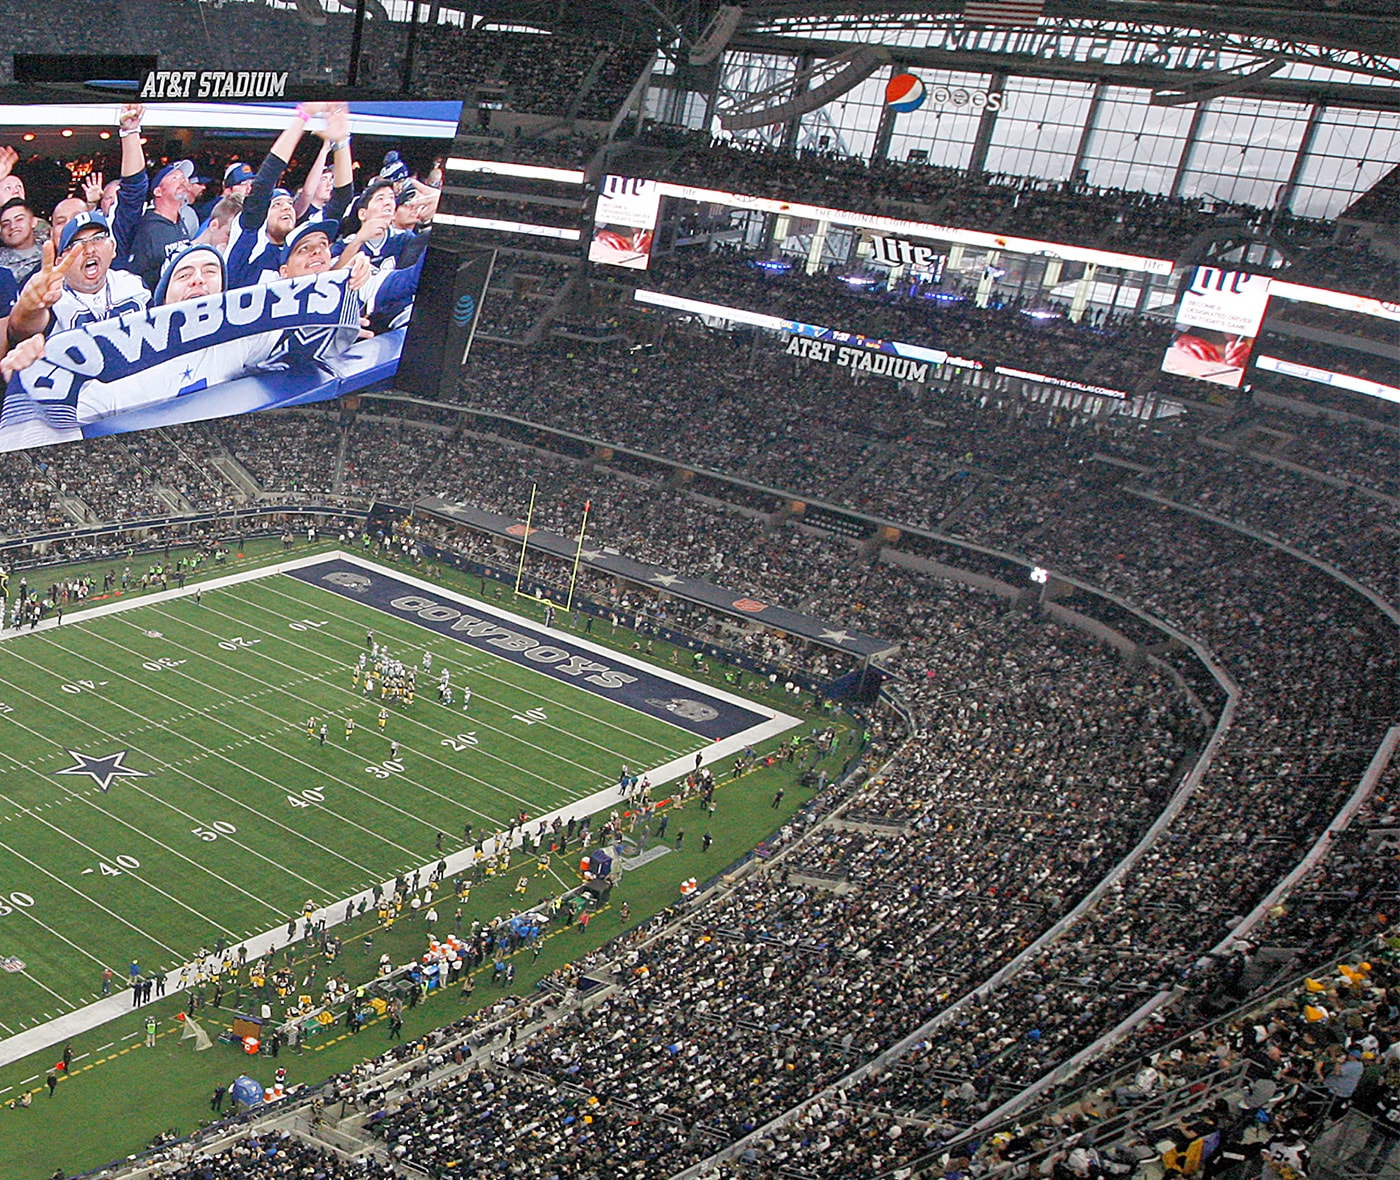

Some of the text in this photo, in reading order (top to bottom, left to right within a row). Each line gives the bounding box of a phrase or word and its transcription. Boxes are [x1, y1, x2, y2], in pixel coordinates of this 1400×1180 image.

[140, 71, 288, 98] AT&T STADIUM
[870, 235, 934, 268] Lite
[19, 272, 348, 400] COWBOYS
[786, 336, 835, 363] AT&T
[837, 347, 929, 384] STADIUM
[289, 618, 322, 631] 10
[218, 637, 254, 650] 20
[390, 595, 638, 690] COWBOYS
[142, 657, 179, 671] 30
[61, 680, 95, 693] 40
[512, 710, 547, 725] 10
[441, 733, 478, 751] 20
[365, 760, 404, 778] 30
[287, 789, 325, 808] 40
[191, 821, 236, 841] 50
[99, 854, 140, 876] 40
